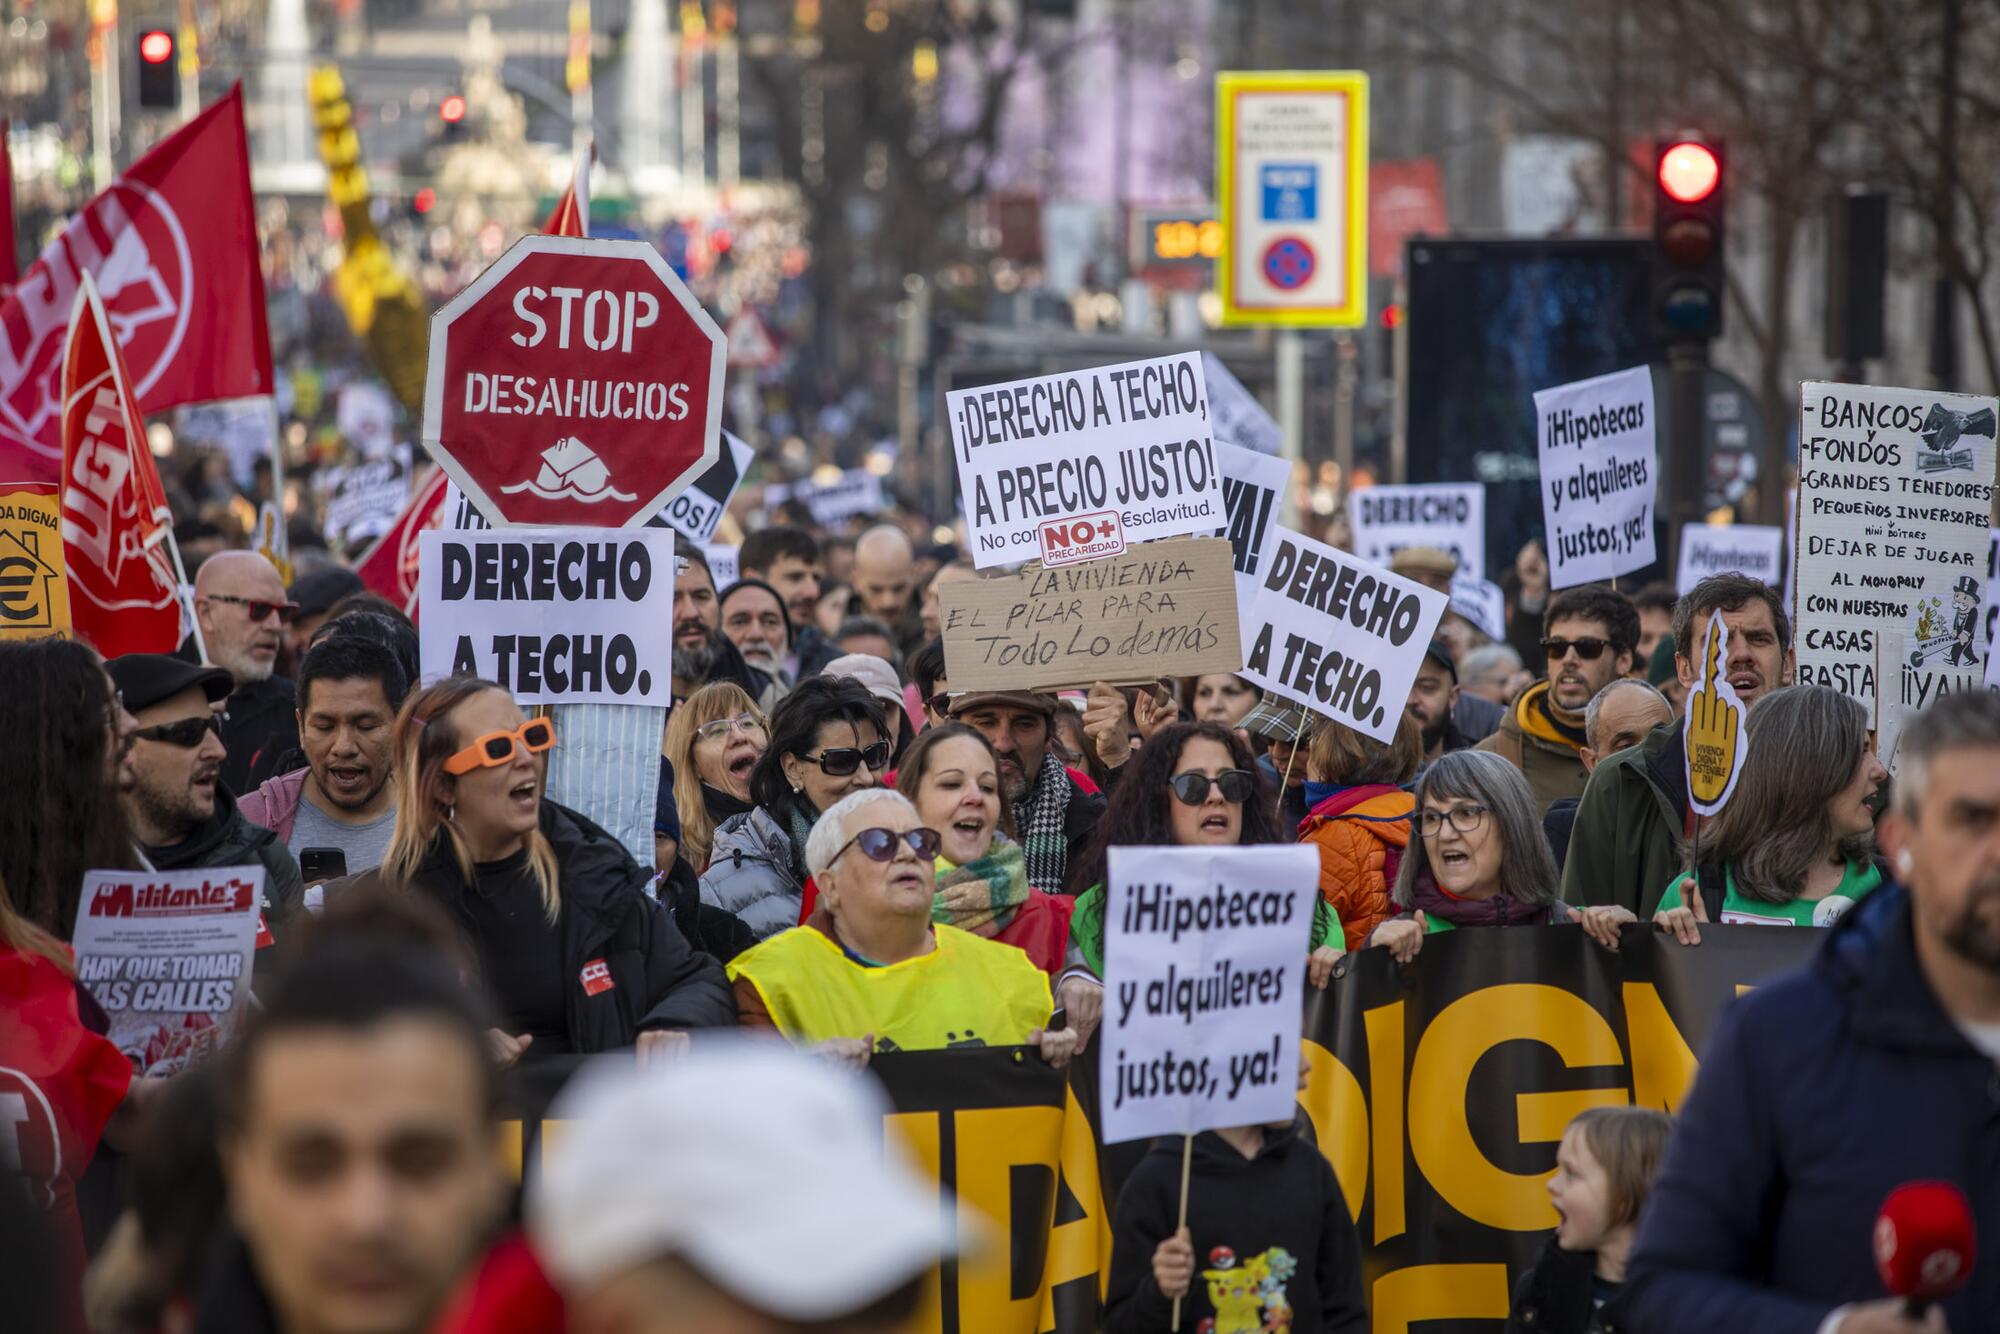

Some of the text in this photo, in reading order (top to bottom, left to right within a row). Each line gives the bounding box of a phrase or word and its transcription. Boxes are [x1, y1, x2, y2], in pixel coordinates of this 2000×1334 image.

[511, 286, 659, 353] STOP
[464, 372, 690, 421] DESAHUCIOS
[957, 377, 1086, 463] ¡DERECHO
[1092, 375, 1111, 428] A
[1110, 360, 1206, 422] TECHO,
[975, 438, 1218, 528] A PRECIO JUSTO!
[1551, 479, 1562, 512] y
[1568, 456, 1648, 504] alquileres
[1898, 477, 1992, 501] TENEDORES
[18, 506, 58, 530] DIGNA
[1361, 495, 1470, 525] DERECHO
[1812, 497, 1990, 529] PEQUEÑOS INVERSORES
[980, 533, 1005, 551] No
[1044, 519, 1116, 550] NO+
[1048, 541, 1119, 561] PRECARIEDAD
[1556, 504, 1648, 567] justos, ya!
[1809, 536, 1974, 566] DEJAR DE JUGAR
[441, 540, 652, 603] DERECHO
[1264, 539, 1421, 647] DERECHO
[1831, 572, 1925, 590] AL MONOPOLY
[946, 608, 985, 631] EL
[1102, 591, 1176, 618] PARA
[1806, 594, 1909, 618] CON NUESTRAS
[975, 630, 1058, 666] Todo
[1117, 611, 1220, 657] demás
[1806, 628, 1873, 653] CASAS
[452, 633, 652, 696] A TECHO.
[1247, 622, 1385, 729] A TECHO.
[1122, 883, 1296, 943] ¡Hipotecas
[79, 953, 243, 981] HAY QUE TOMAR
[83, 980, 234, 1012] AS CALLES
[1118, 959, 1285, 1028] y alquileres
[1114, 1034, 1281, 1109] justos, ya!
